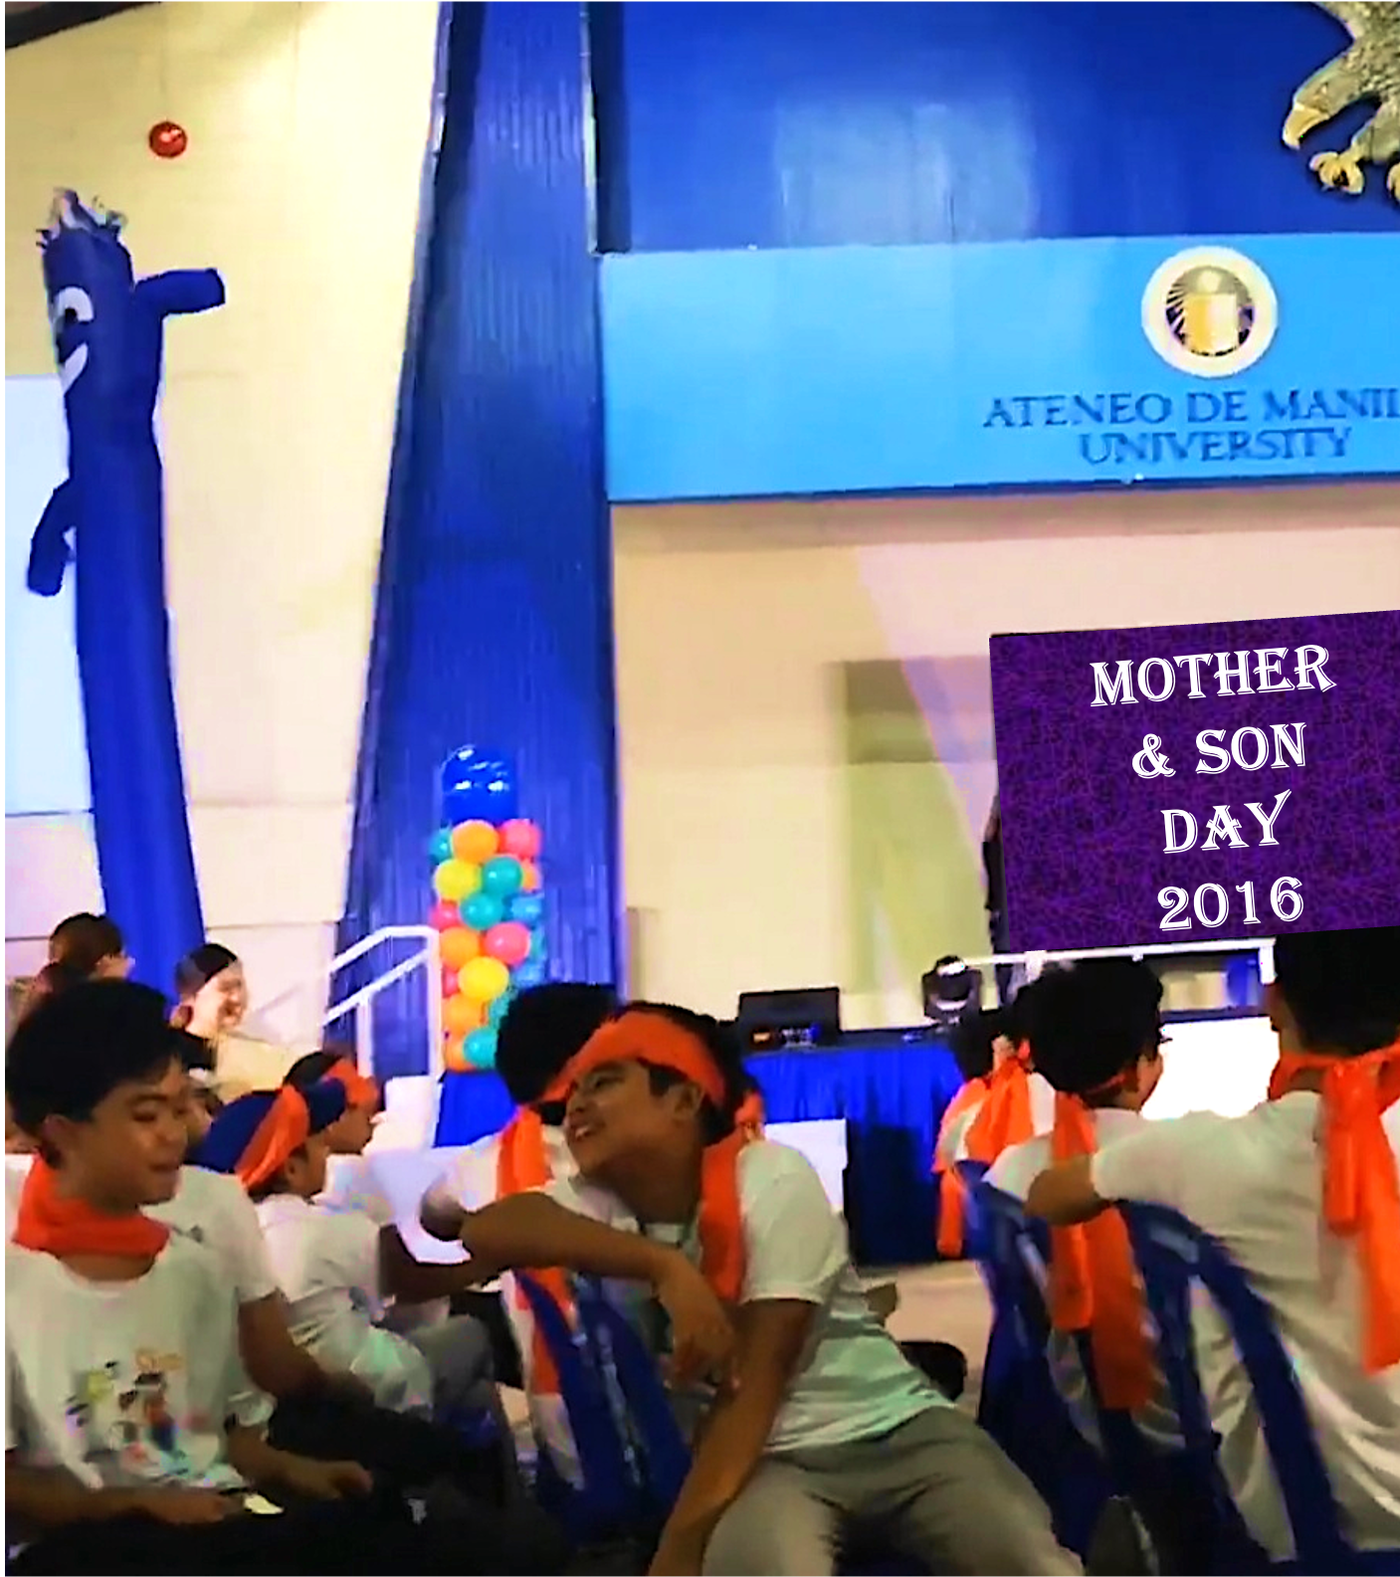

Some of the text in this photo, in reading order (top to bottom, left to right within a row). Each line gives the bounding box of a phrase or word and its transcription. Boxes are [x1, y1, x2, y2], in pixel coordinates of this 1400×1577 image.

[983, 392, 1172, 428] ATENEO
[1187, 390, 1248, 423] DE
[1080, 427, 1351, 465] UNIVERSITY
